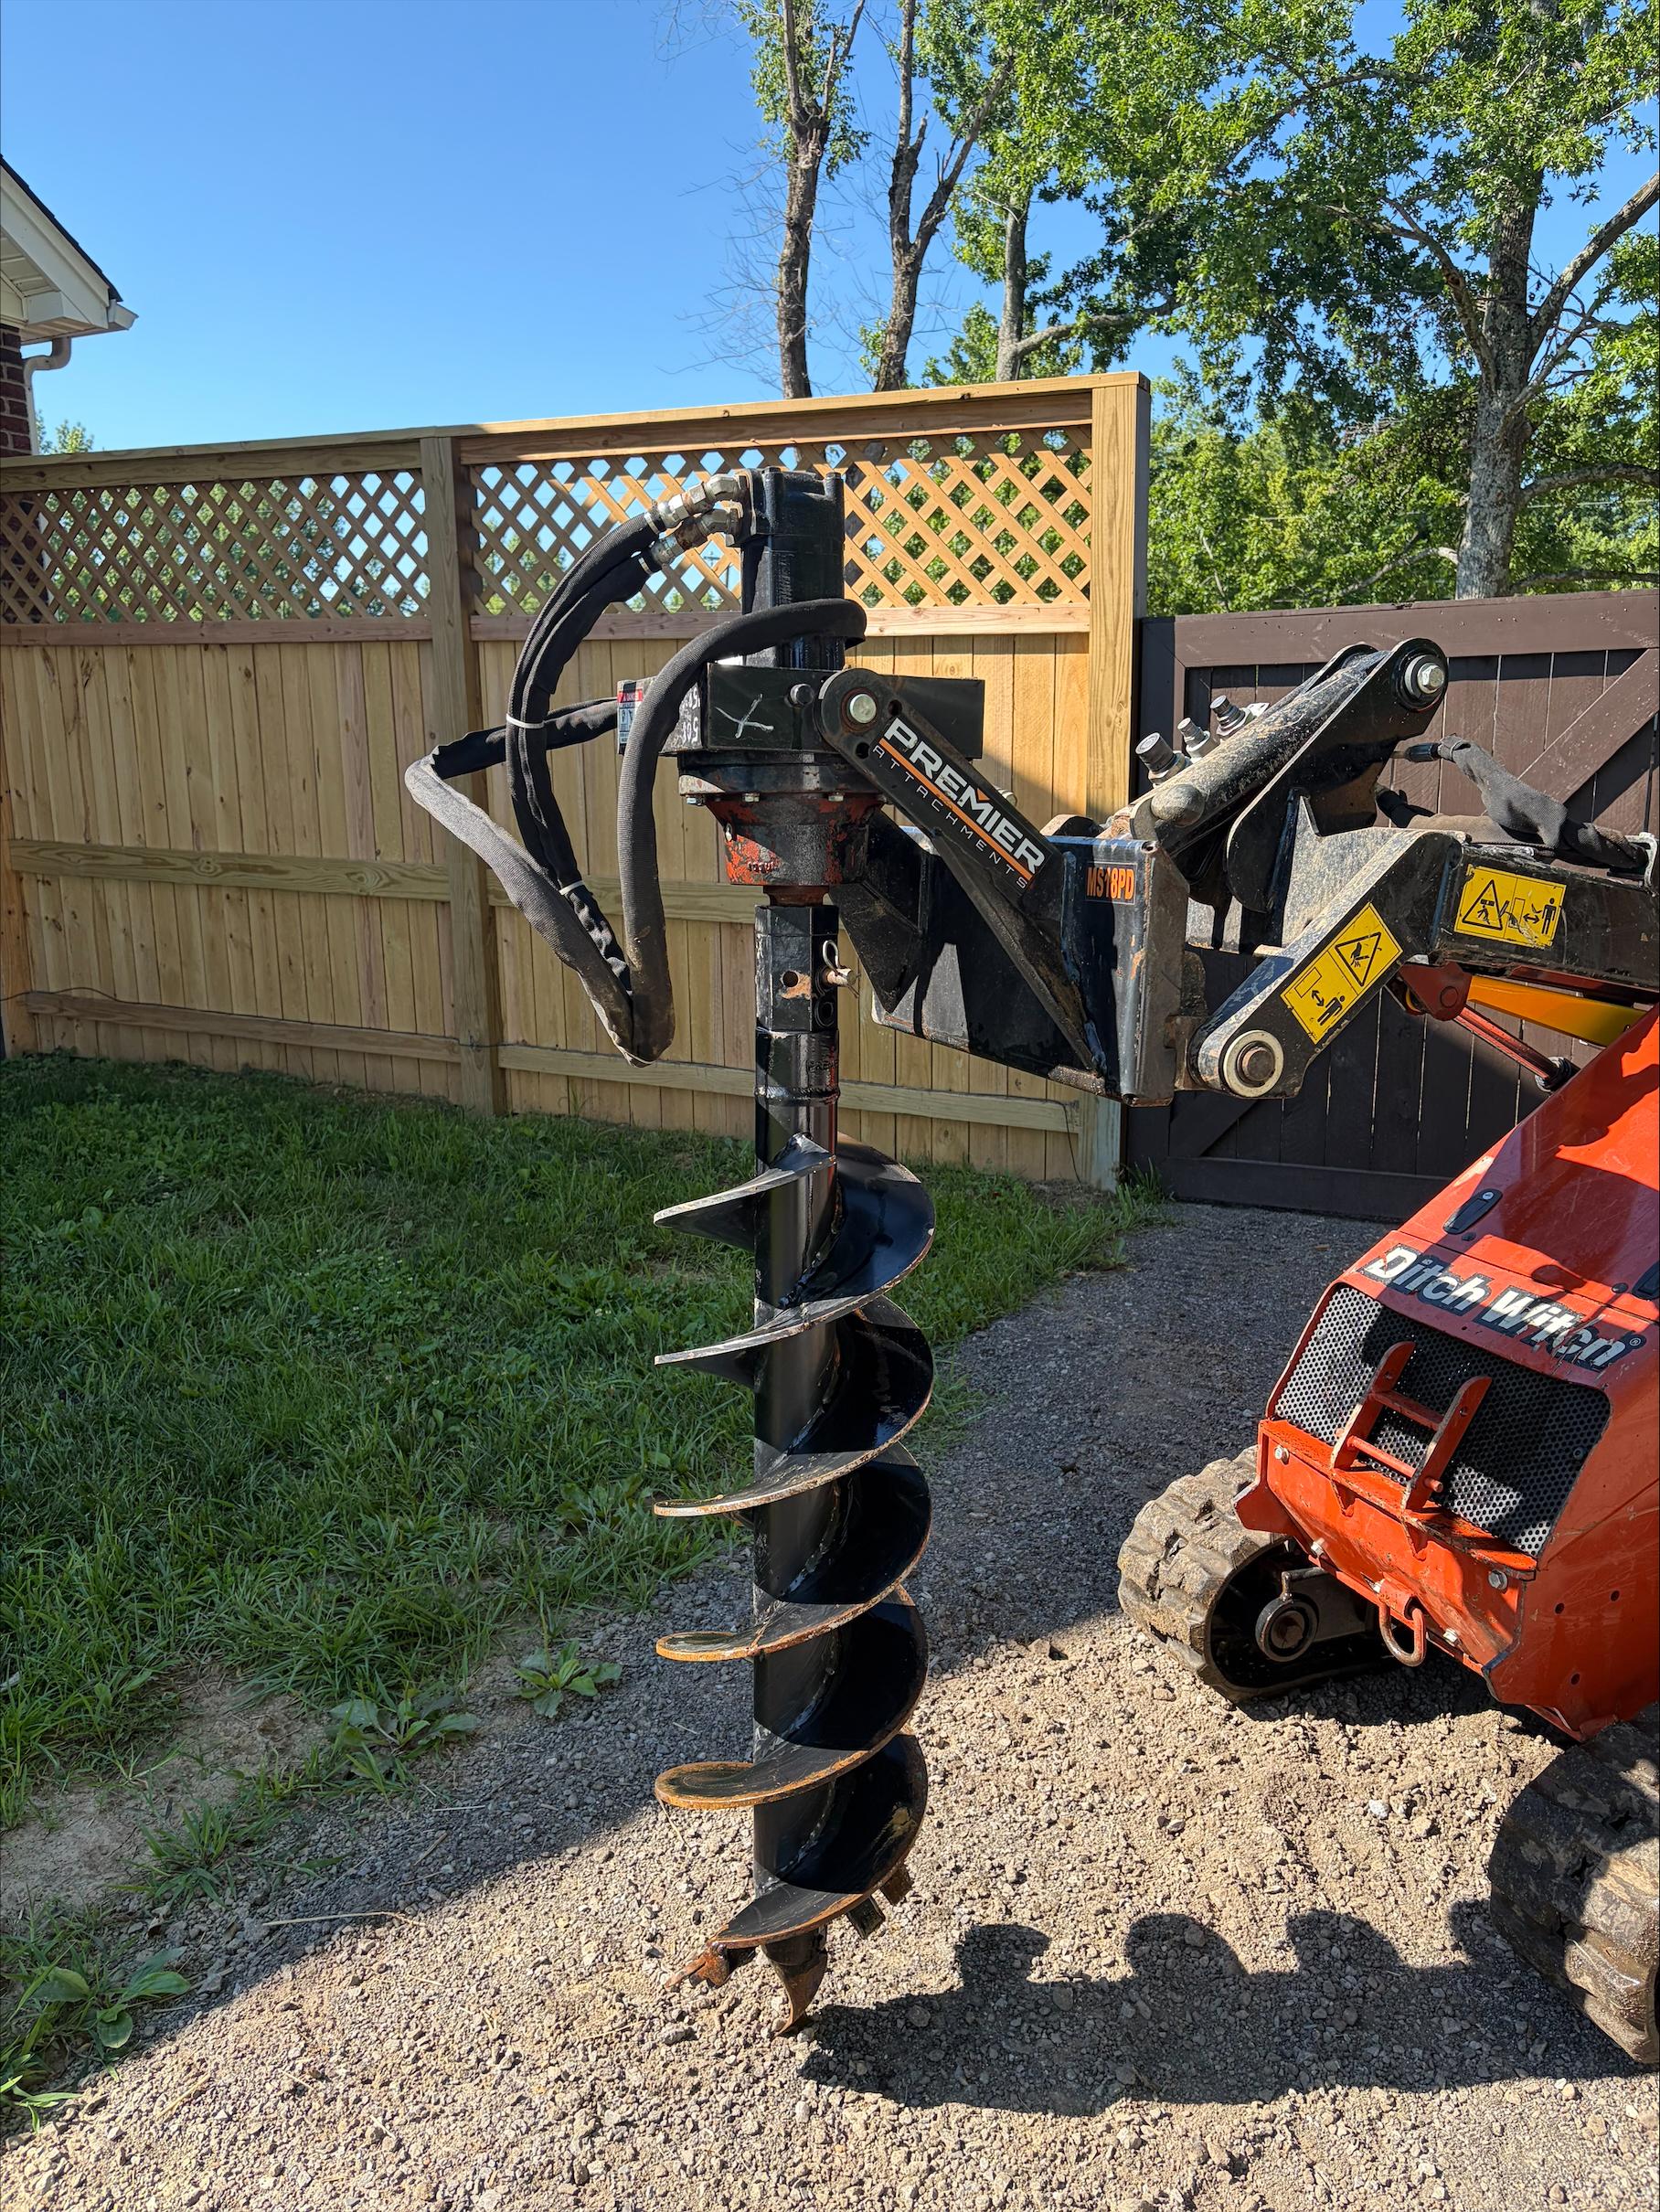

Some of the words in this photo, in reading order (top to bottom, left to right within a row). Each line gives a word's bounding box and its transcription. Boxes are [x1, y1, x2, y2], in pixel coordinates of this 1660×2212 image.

[872, 744, 1029, 889] ATTACHMENTS
[883, 717, 1046, 875] PREMIER
[1086, 866, 1134, 900] MS18PD
[1366, 1245, 1489, 1312] Ditch
